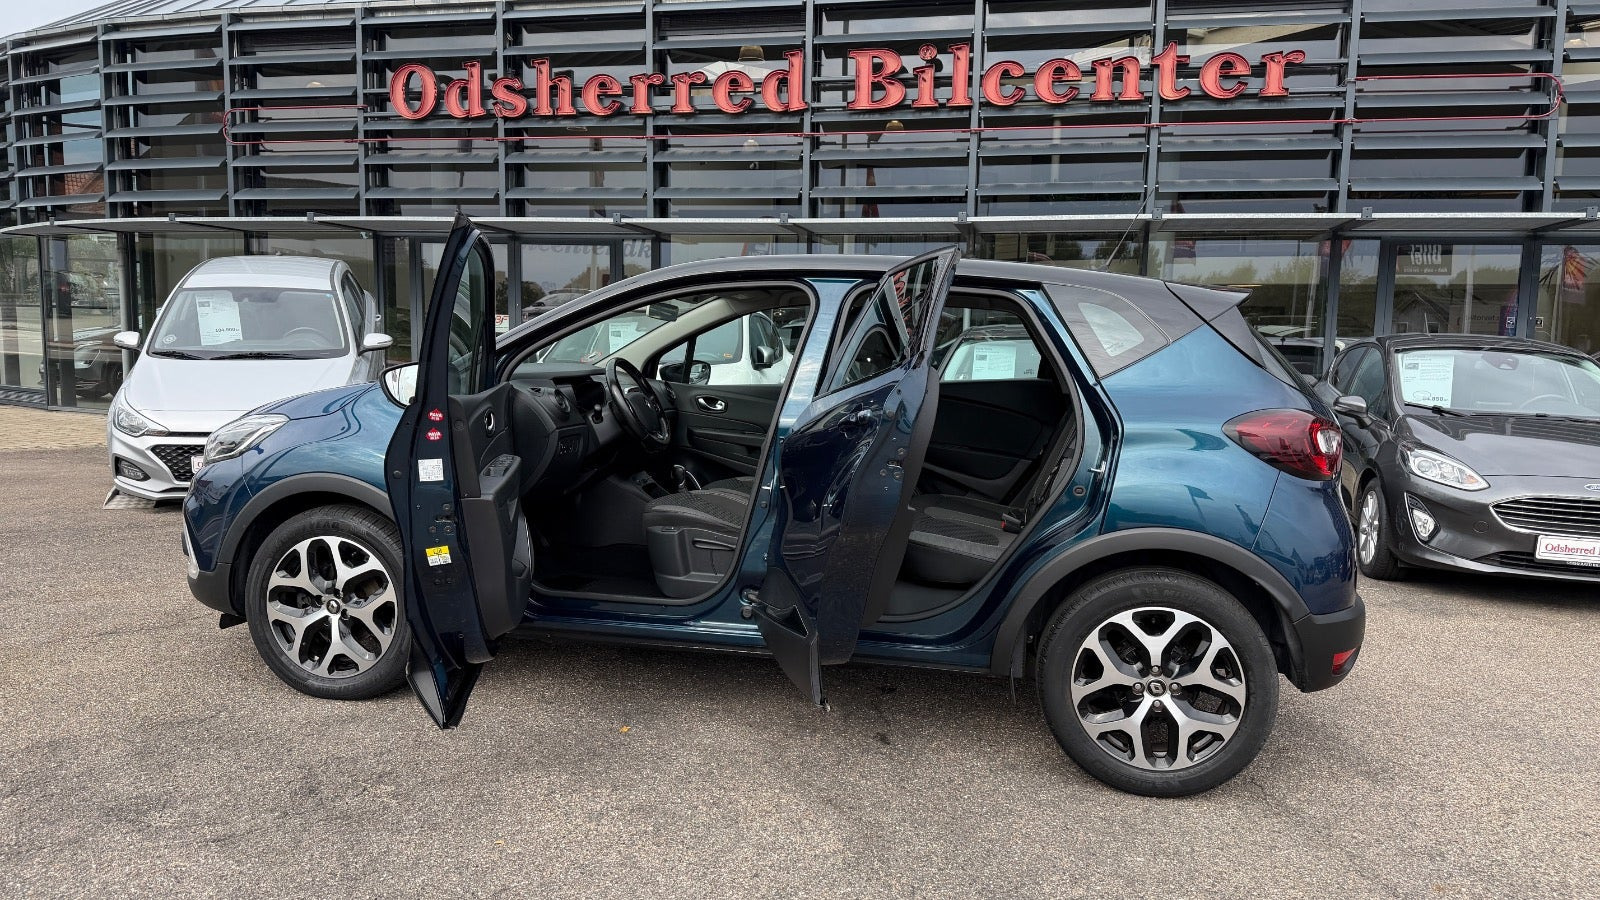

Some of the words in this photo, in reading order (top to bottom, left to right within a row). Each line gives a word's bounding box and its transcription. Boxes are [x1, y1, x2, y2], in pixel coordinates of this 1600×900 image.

[389, 49, 808, 120] Odsherred
[847, 42, 1306, 110] Bilcenter
[1545, 543, 1596, 555] Odsherred
